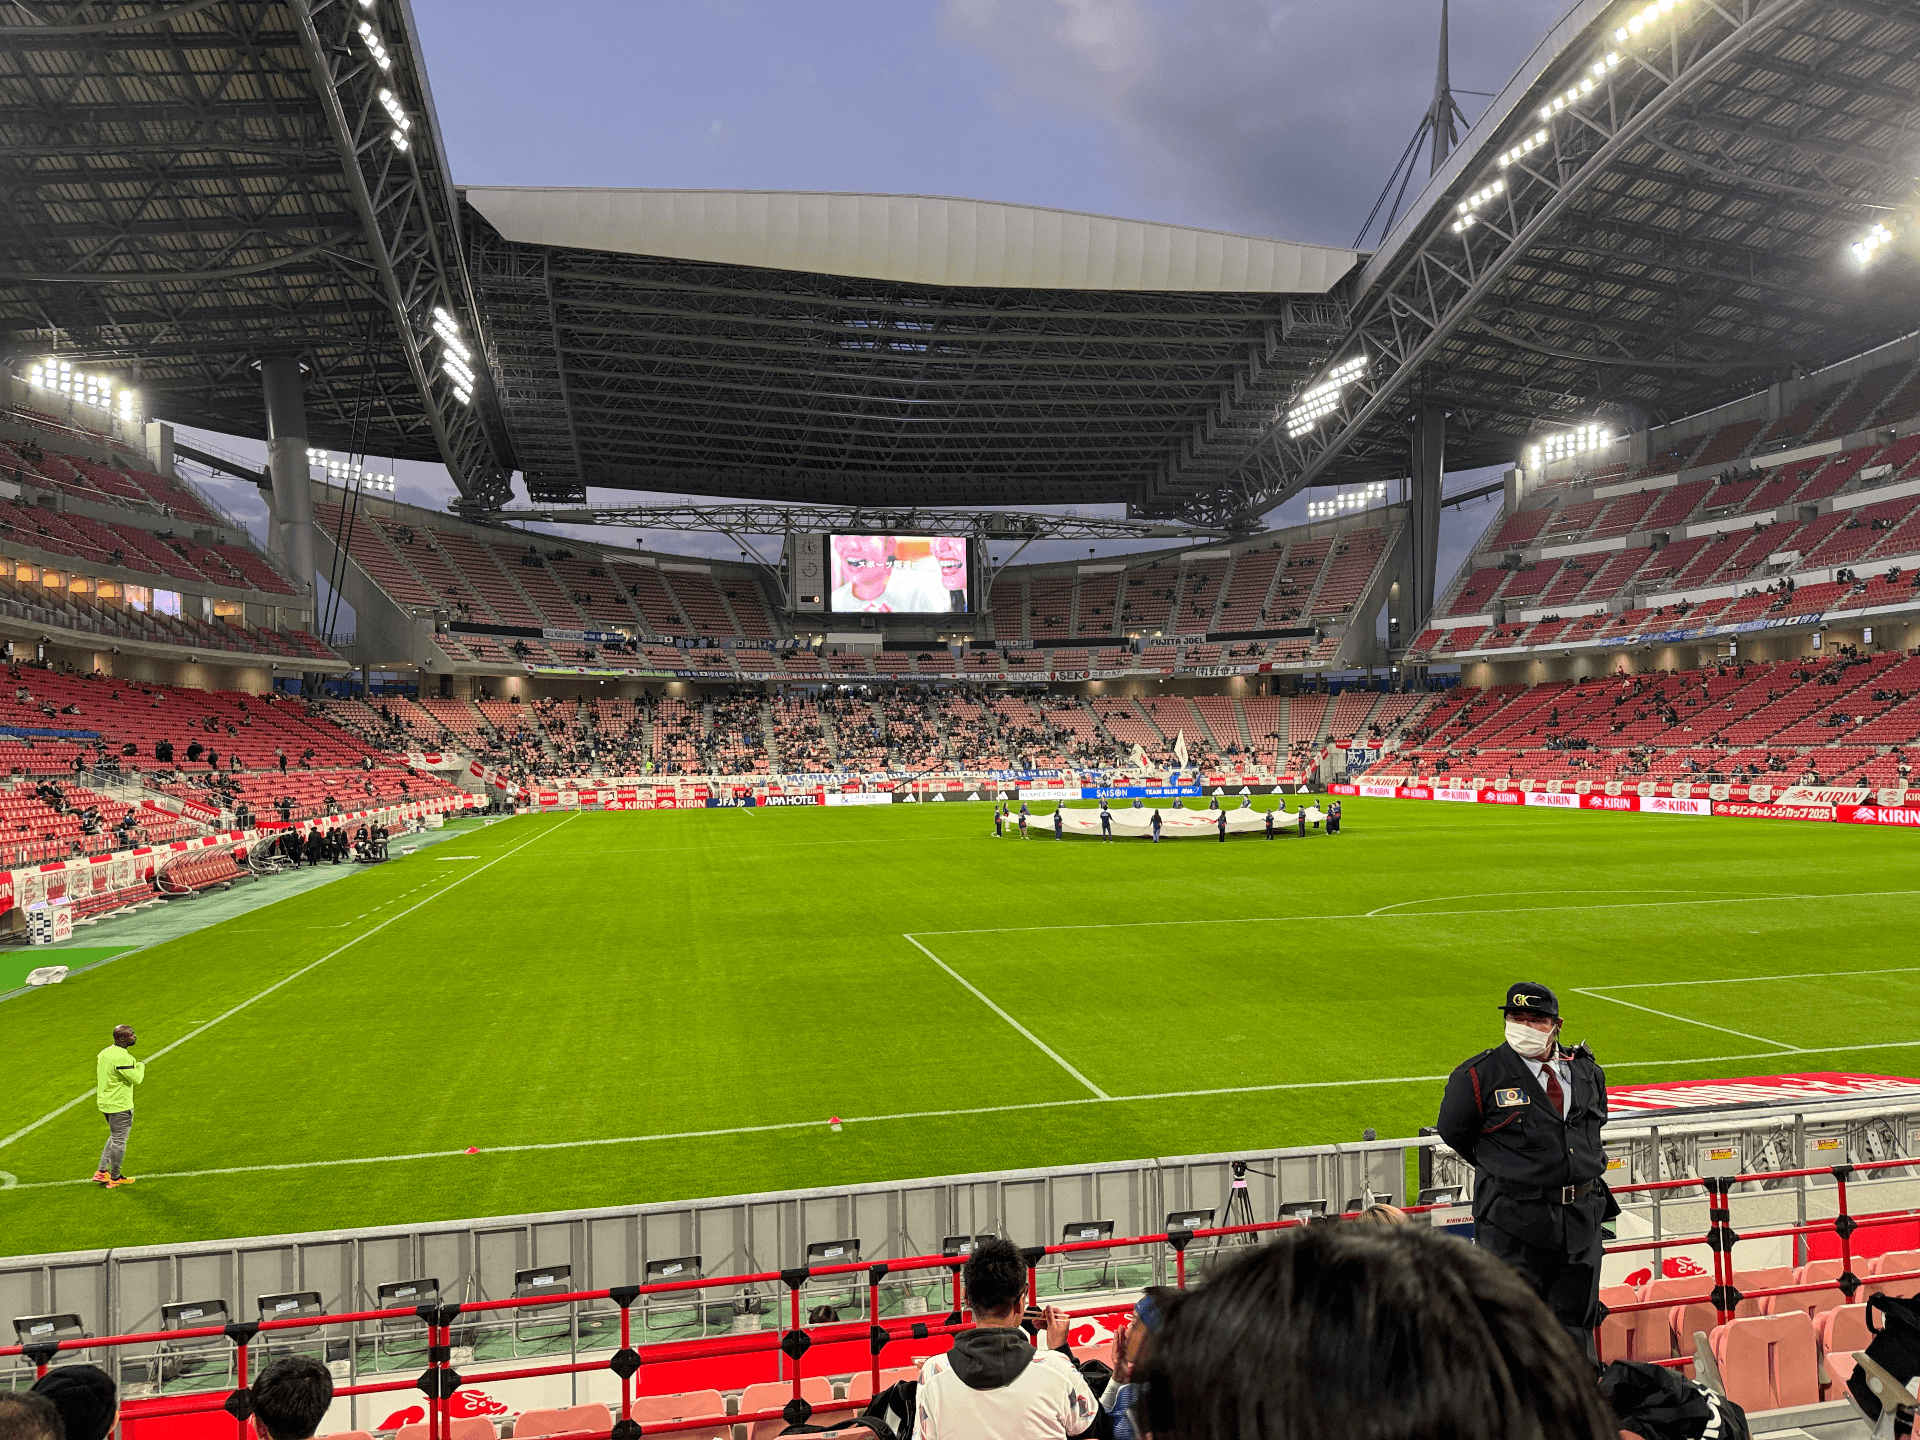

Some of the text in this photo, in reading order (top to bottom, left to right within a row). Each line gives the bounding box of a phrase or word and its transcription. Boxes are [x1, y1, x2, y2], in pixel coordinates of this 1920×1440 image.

[1150, 637, 1205, 646] FUJITA JOEL
[1374, 778, 1402, 786] KIRIN
[1096, 789, 1128, 797] SAISON
[1374, 787, 1390, 796] KIRIN
[1621, 784, 1638, 792] KIRIN
[1655, 785, 1672, 793] KIRIN
[1691, 786, 1709, 794] KIRIN
[1729, 787, 1749, 796] KIRIN
[1411, 789, 1428, 798] KIRIN
[1451, 790, 1470, 800] KIRIN
[1496, 792, 1518, 803] KIRIN
[1813, 791, 1863, 803] KIRIN
[676, 799, 707, 809] KIRIN
[717, 798, 746, 808] JFA.jp
[765, 795, 819, 806] APA HOTEL
[1547, 794, 1571, 805] KIRIN
[1603, 797, 1632, 809] KIRIN
[625, 800, 656, 810] KIRIN
[1668, 800, 1698, 813] KIRIN
[1729, 804, 1830, 820] キリンチャレンジカップ 2025
[1878, 808, 1920, 825] KIRIN
[55, 926, 71, 937] KIRIN
